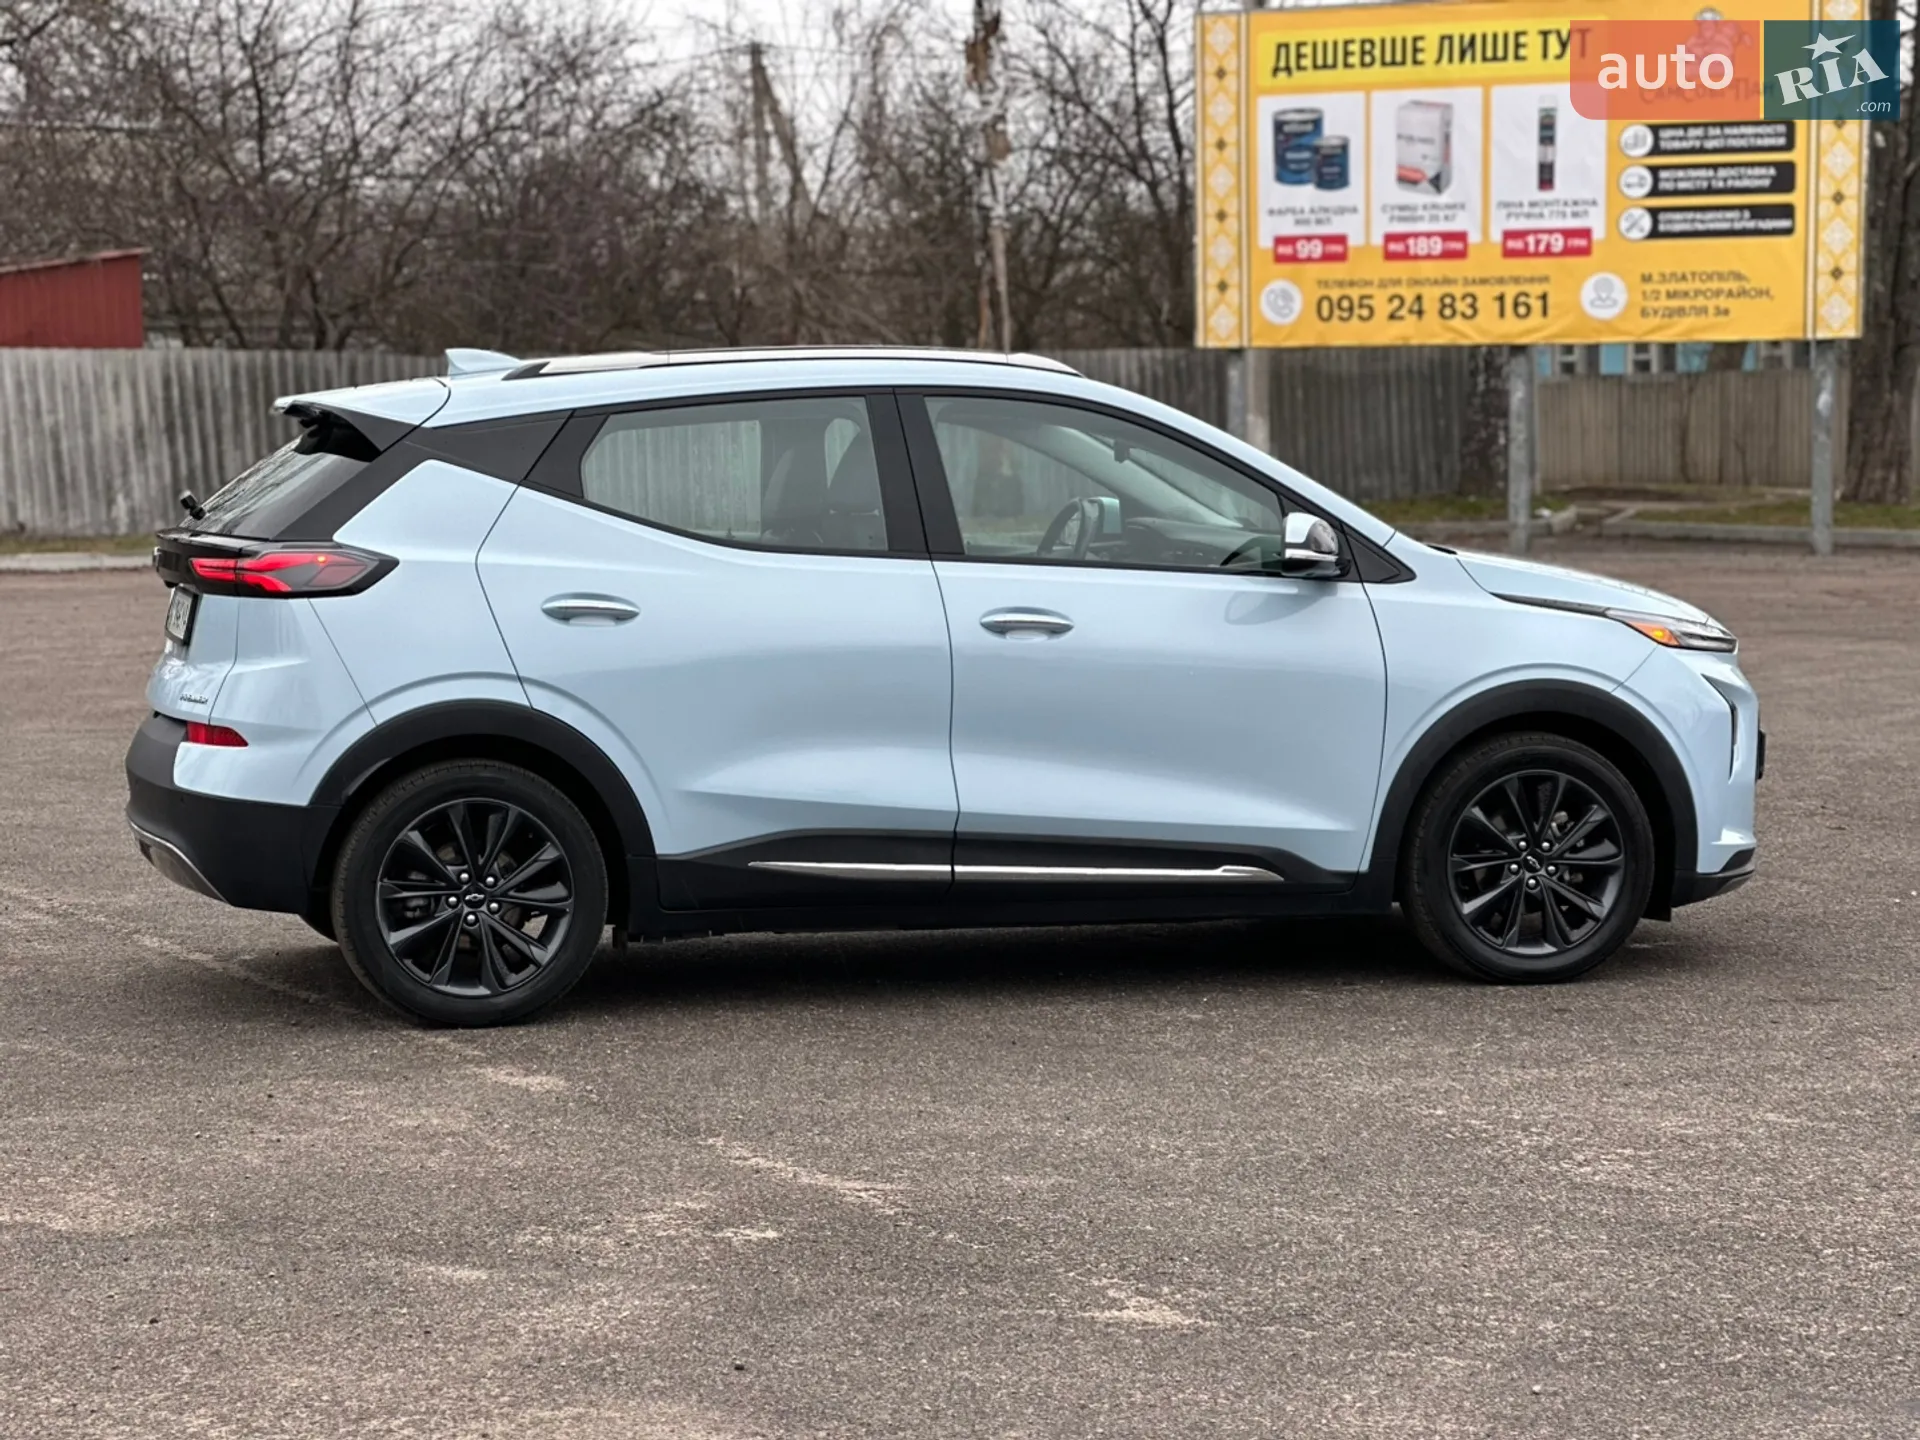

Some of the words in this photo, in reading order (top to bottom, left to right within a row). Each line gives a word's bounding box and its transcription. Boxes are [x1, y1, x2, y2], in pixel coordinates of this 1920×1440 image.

[1272, 36, 1426, 77] ДЕШЕВШЕ
[1435, 31, 1529, 64] ЛИШЕ
[1538, 28, 1591, 60] ТУТ
[1716, 165, 1777, 178] ДОСТАВКА
[1295, 238, 1324, 260] 99
[1406, 235, 1443, 257] 189
[1526, 232, 1565, 254] 179
[1317, 277, 1374, 289] ТЕЛЕФОН
[1377, 277, 1403, 289] ДЛЯ
[1406, 275, 1458, 287] ОНЛАЙН
[1462, 274, 1551, 287] ЗАМОВЛЕННЯ
[1316, 293, 1375, 323] 095
[1387, 293, 1425, 321] 24
[1438, 292, 1479, 321] 83
[1492, 291, 1550, 319] 161
[1640, 305, 1709, 319] БУДІВЛЯ
